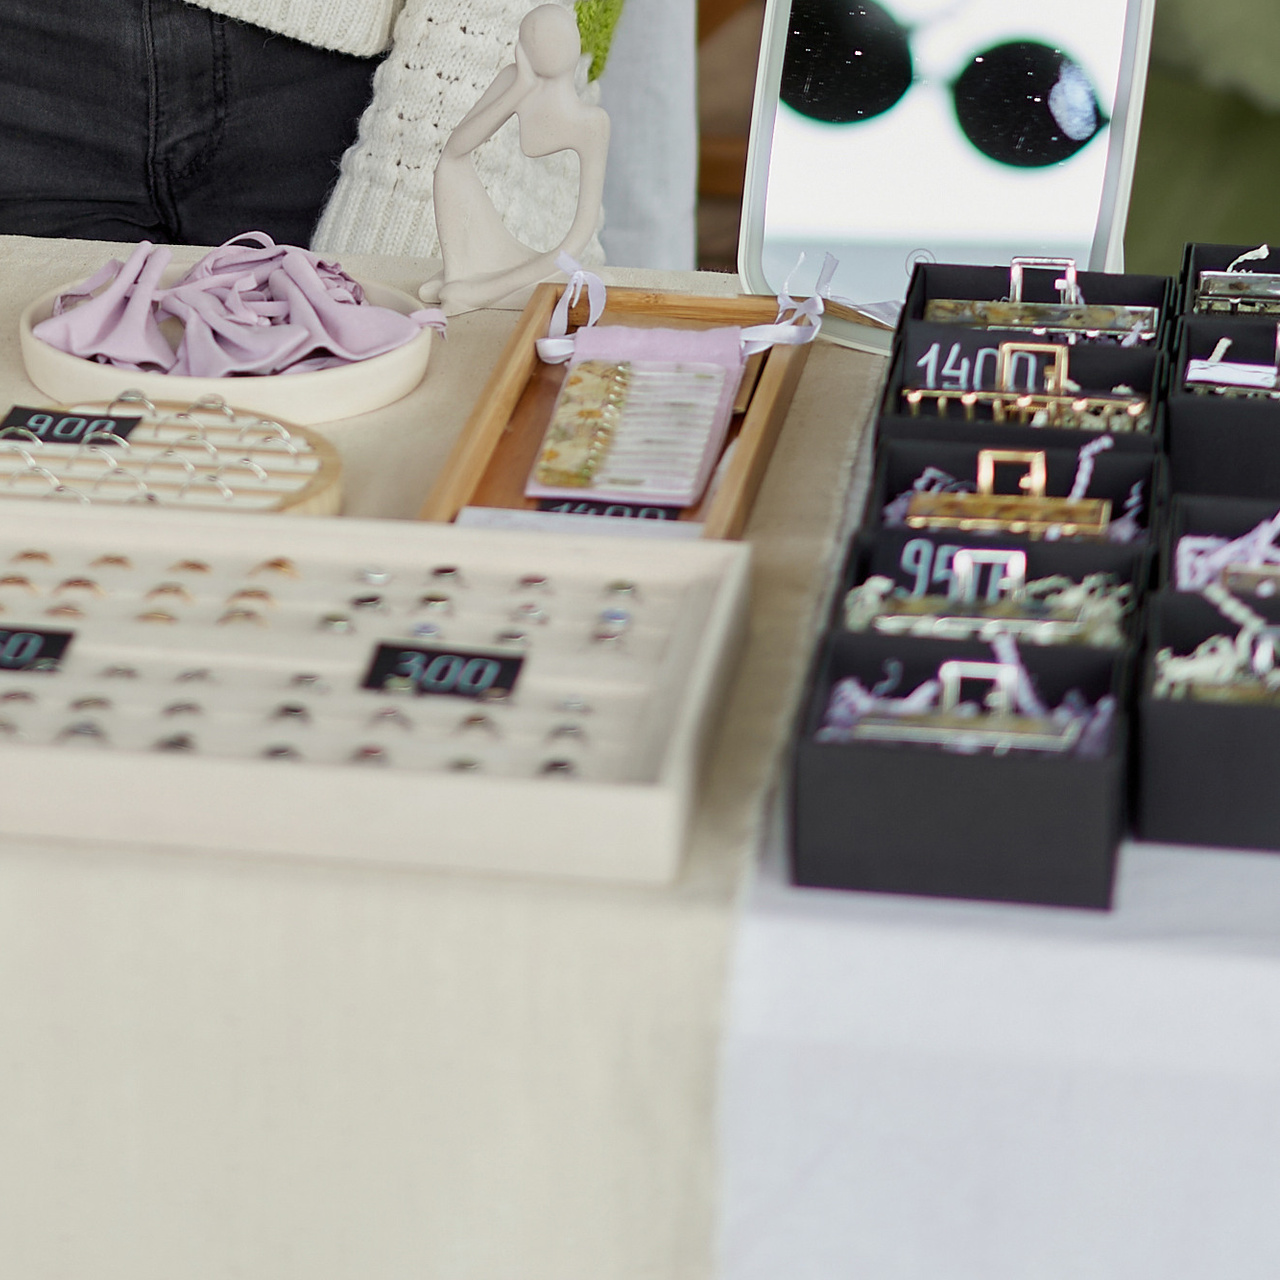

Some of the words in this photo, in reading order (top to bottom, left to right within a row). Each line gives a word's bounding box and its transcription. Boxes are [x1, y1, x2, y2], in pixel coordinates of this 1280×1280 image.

[916, 342, 1038, 394] 1400
[26, 413, 117, 440] 900
[387, 650, 501, 693] 300
